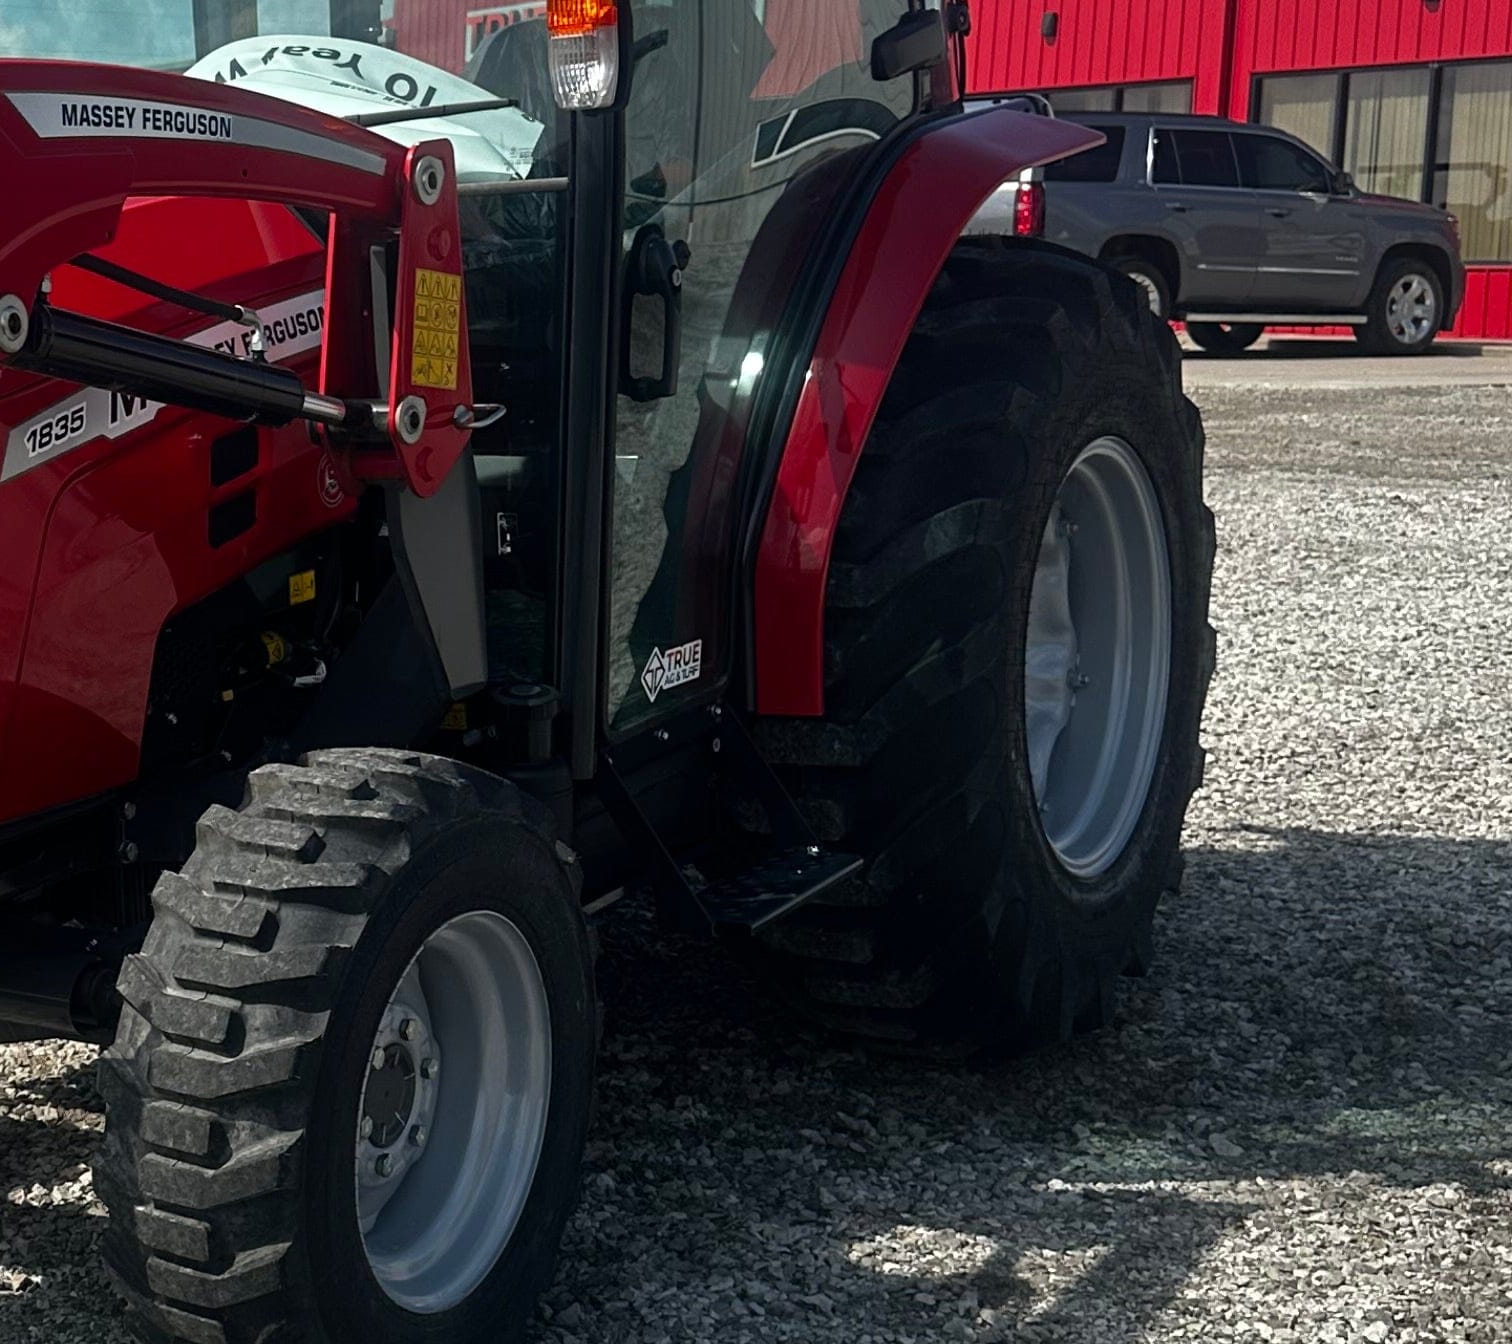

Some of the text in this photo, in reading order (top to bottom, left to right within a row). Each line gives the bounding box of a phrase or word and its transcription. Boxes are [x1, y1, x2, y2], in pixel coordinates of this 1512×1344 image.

[261, 45, 365, 80] Year
[384, 72, 437, 106] 10
[61, 103, 231, 138] MASSEY FERGUSON
[26, 406, 84, 453] 1835
[667, 643, 700, 672] TRUE
